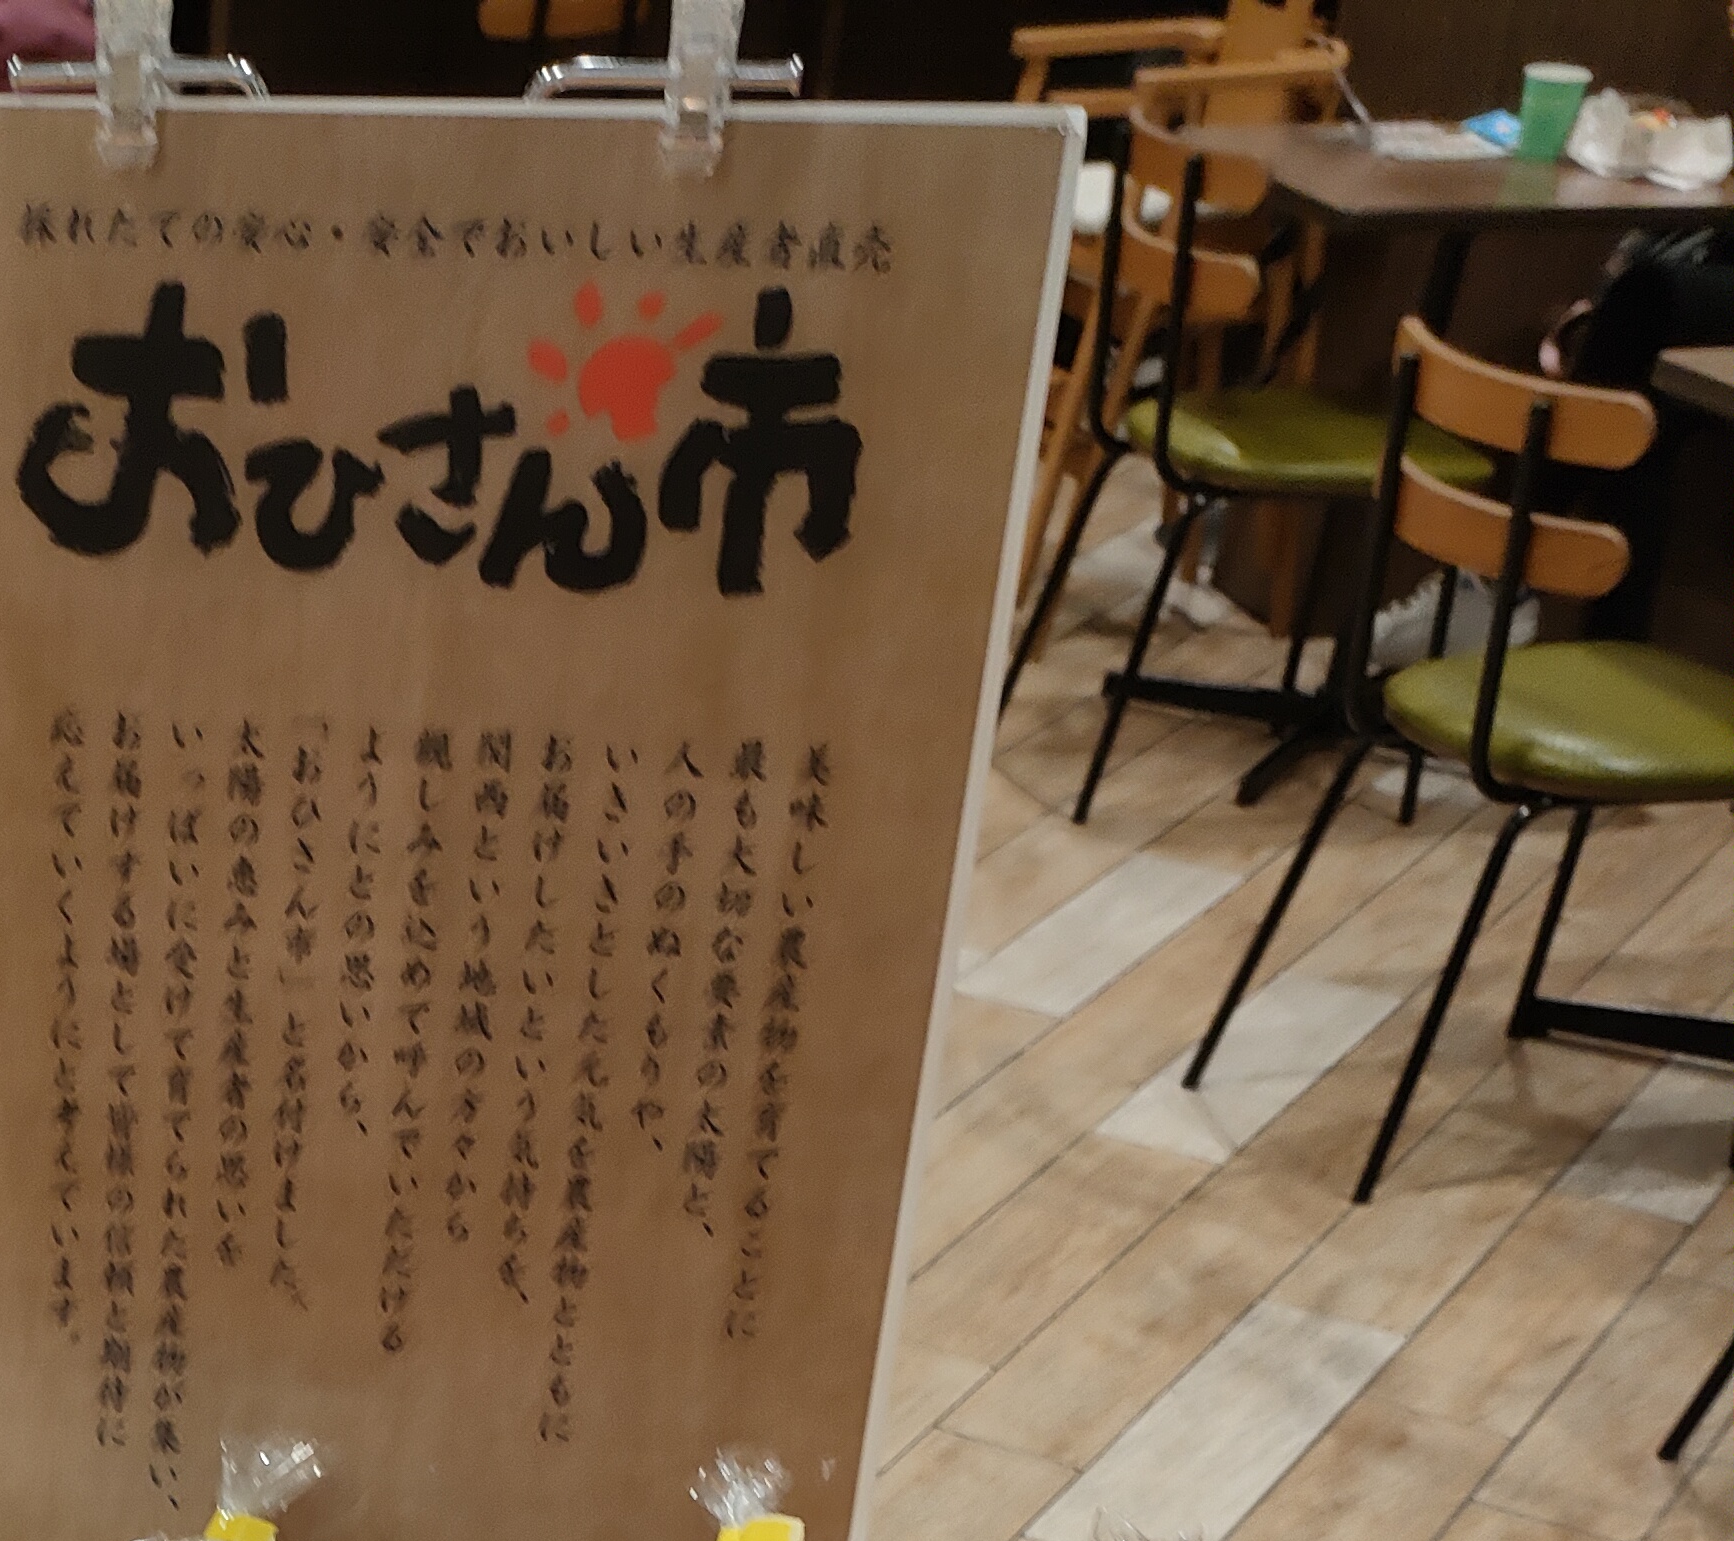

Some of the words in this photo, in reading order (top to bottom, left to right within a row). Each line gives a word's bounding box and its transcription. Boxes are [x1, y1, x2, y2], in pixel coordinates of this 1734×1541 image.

[16, 282, 863, 597] おひさん市
